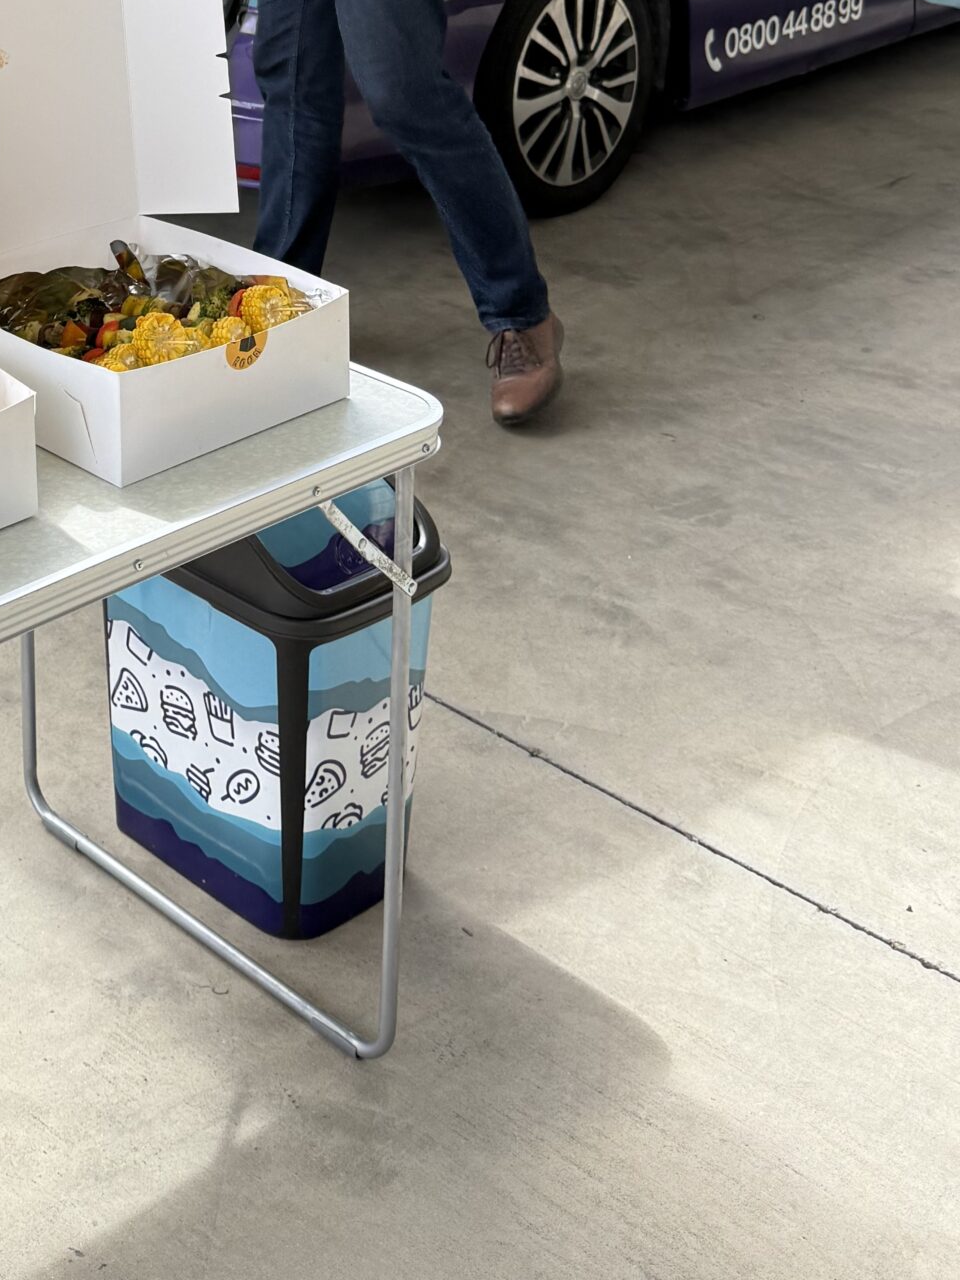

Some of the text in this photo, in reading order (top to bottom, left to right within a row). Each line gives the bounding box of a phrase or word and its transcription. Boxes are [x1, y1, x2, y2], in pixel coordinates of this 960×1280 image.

[724, 15, 780, 58] 0800
[782, 6, 808, 39] 44
[810, 0, 836, 32] 88
